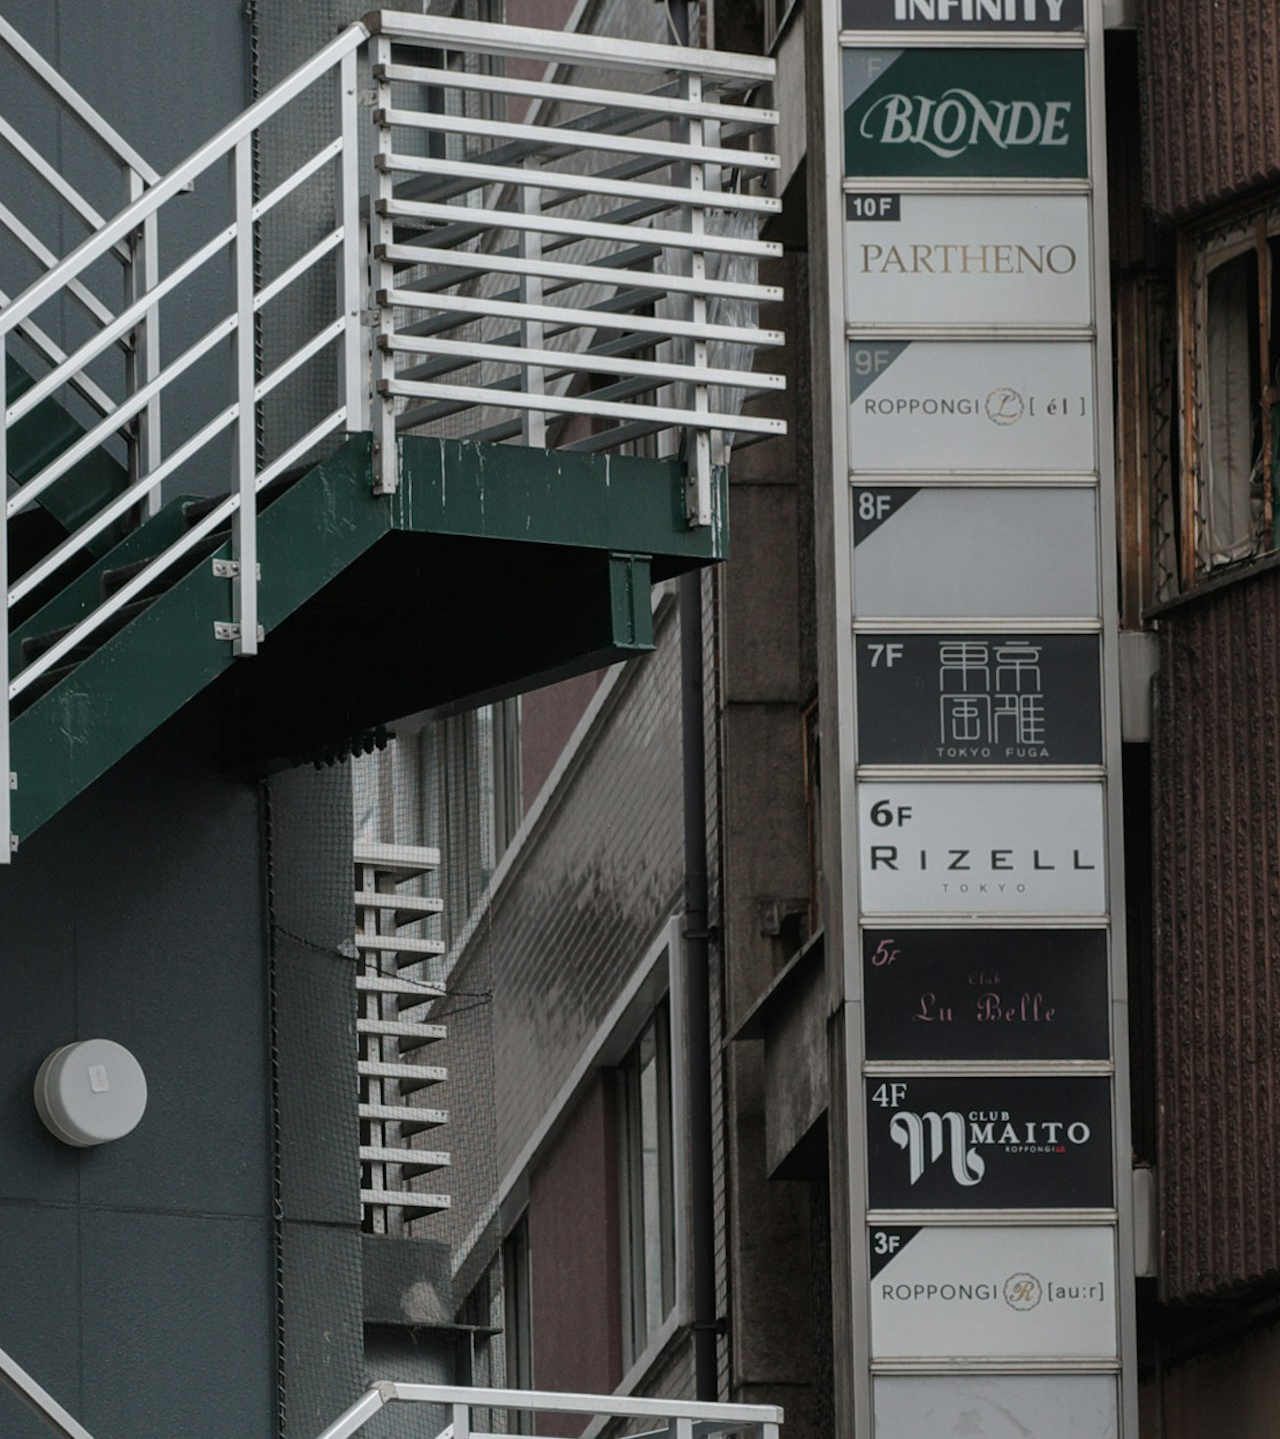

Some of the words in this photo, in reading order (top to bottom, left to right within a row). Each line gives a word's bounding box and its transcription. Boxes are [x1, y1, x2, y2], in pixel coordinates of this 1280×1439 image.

[859, 88, 1072, 159] BLONDE
[853, 198, 892, 217] 10F
[859, 243, 1077, 275] PARTHENO
[855, 349, 890, 375] 9F
[864, 398, 980, 416] ROPPONGI
[858, 492, 891, 520] 8F
[867, 643, 904, 668] 7F
[936, 747, 992, 758] TOKYO
[1005, 747, 1050, 758] FUGA
[870, 799, 912, 828] 6F
[870, 845, 1096, 871] RIZELL
[942, 883, 1026, 894] TOKYO
[872, 939, 901, 966] 5F
[977, 992, 1056, 1022] Belle
[872, 1083, 907, 1108] 4F
[969, 1111, 1010, 1122] CLUB
[969, 1121, 1091, 1145] MAITO
[874, 1232, 901, 1254] 3F
[881, 1284, 997, 1301] ROPPONGI
